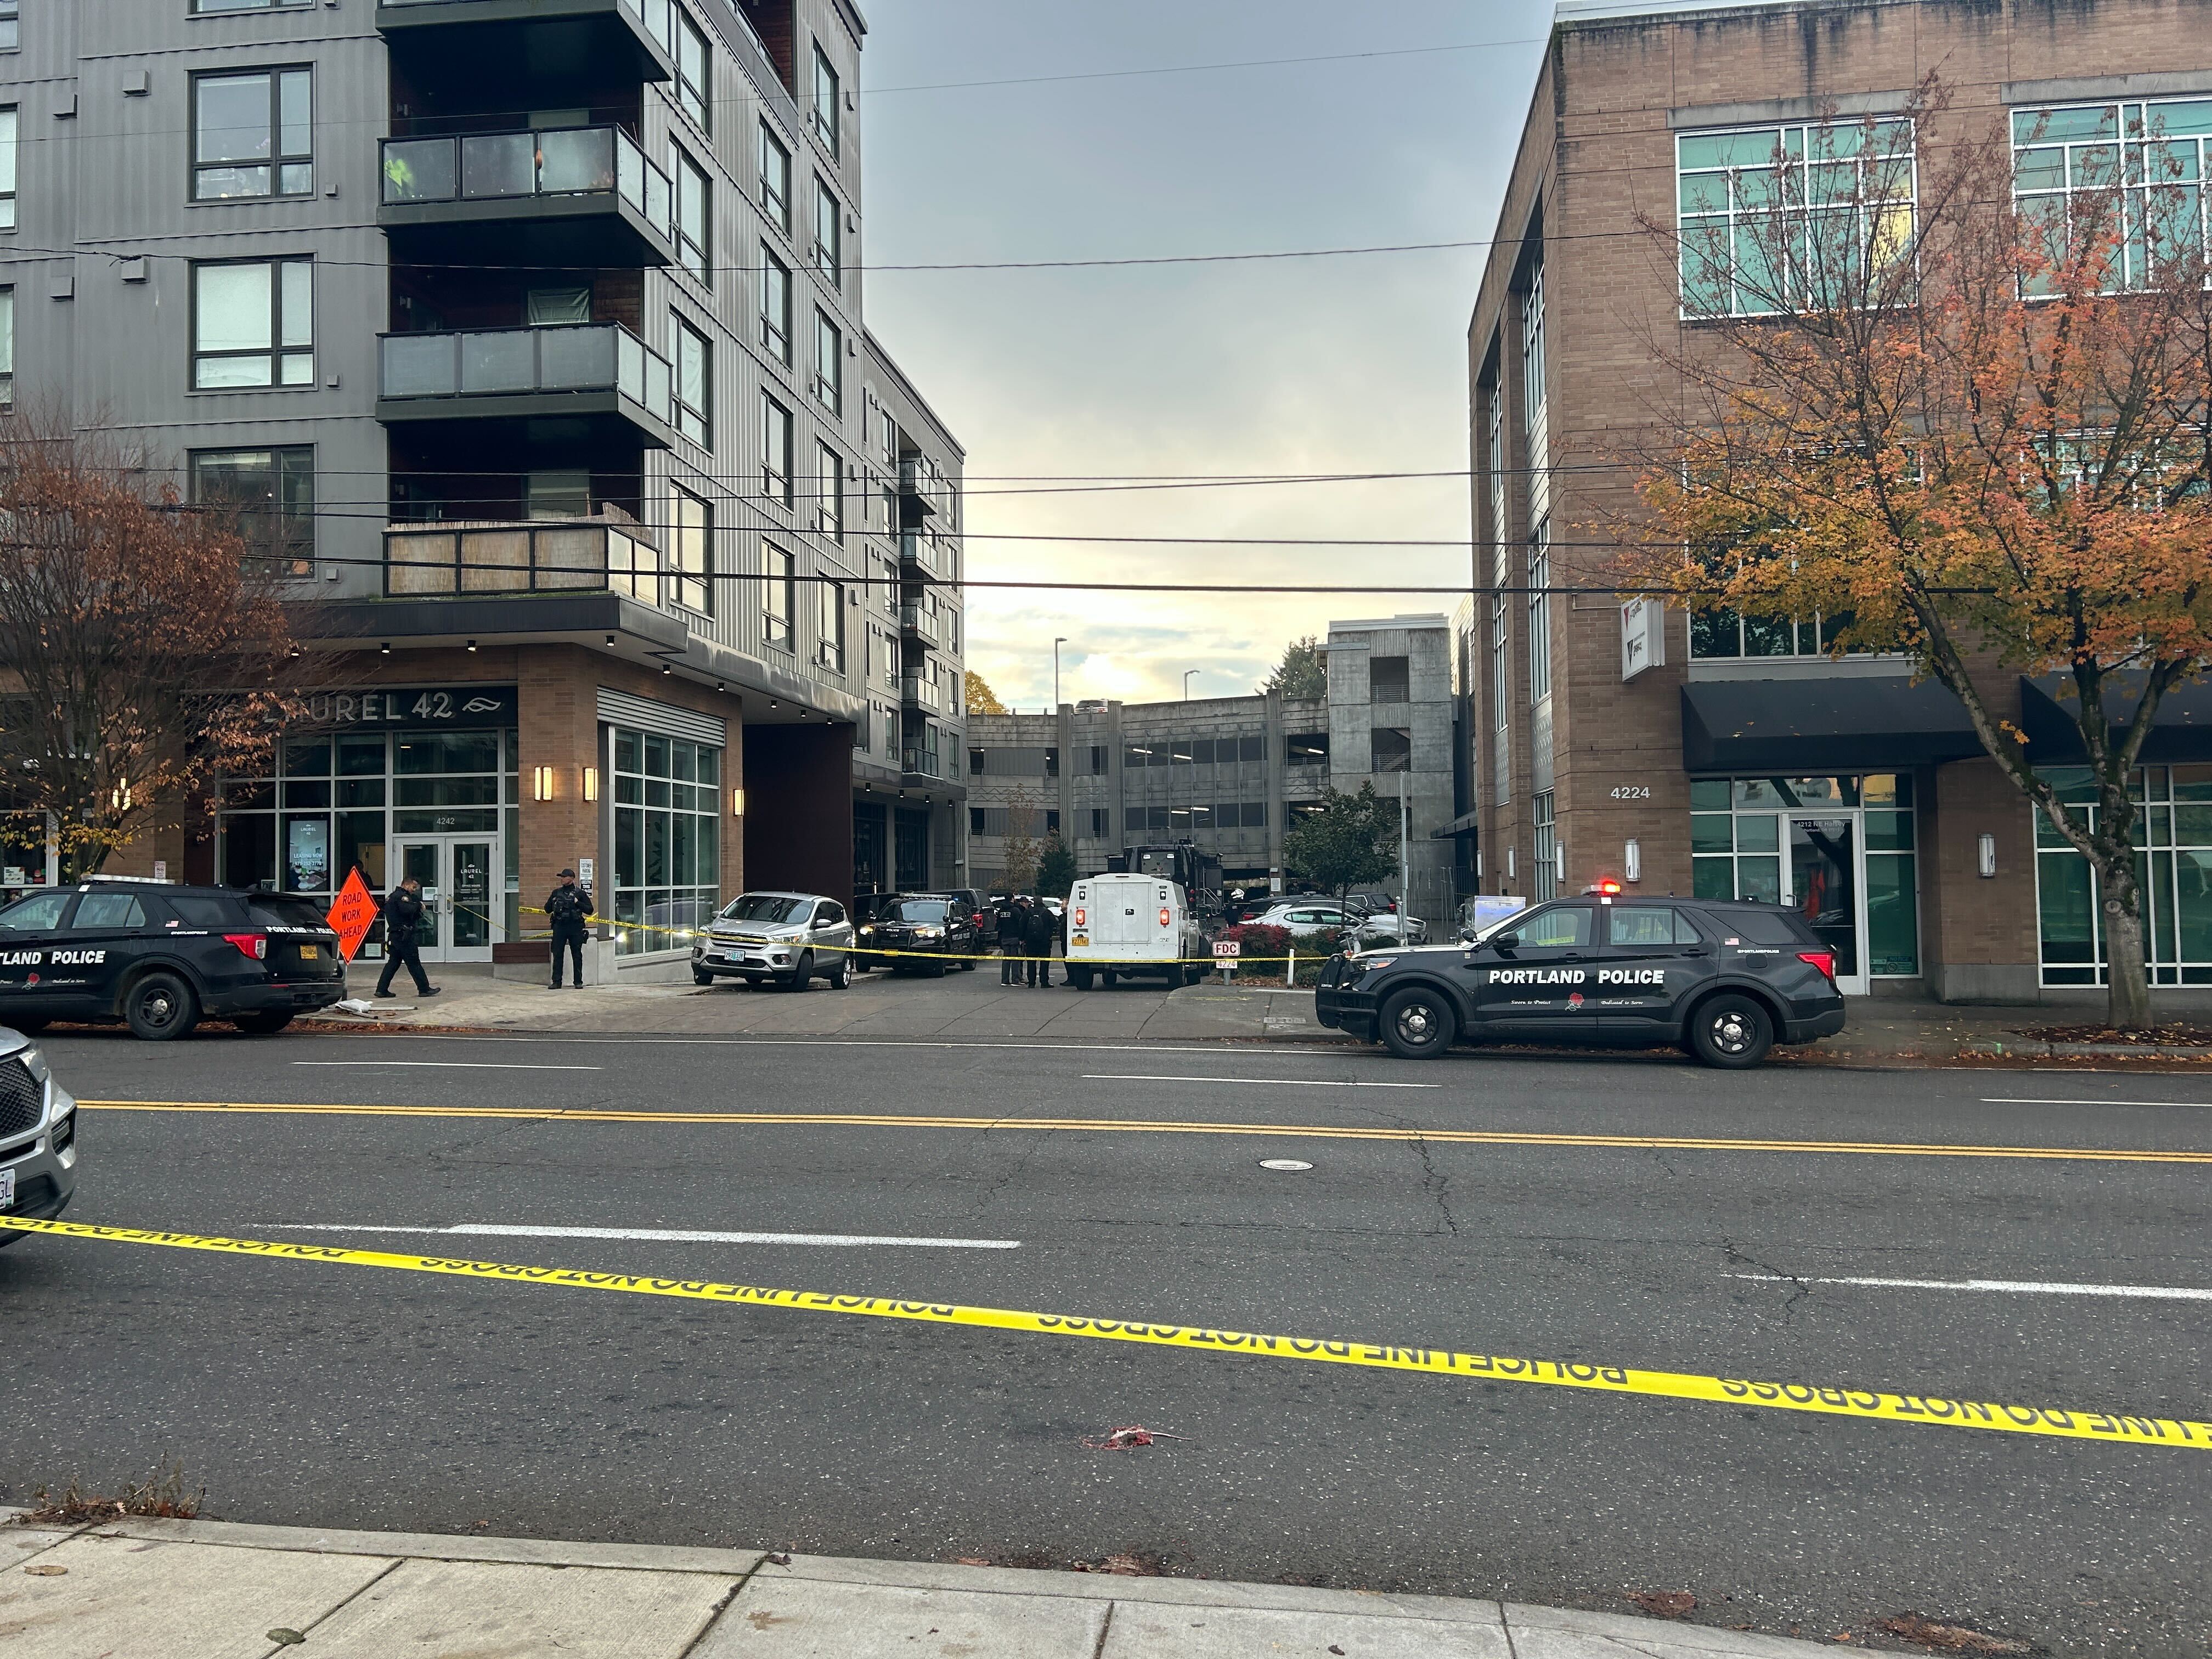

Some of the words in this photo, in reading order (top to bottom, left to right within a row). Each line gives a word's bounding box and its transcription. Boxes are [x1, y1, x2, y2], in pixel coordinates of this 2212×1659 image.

[412, 692, 453, 719] 42
[1610, 787, 1650, 799] 4224
[342, 892, 362, 906] ROAD
[342, 909, 361, 922] WORK
[339, 924, 362, 939] AHEAD
[1216, 944, 1237, 953] FDC
[51, 950, 106, 964] POLICE
[1489, 970, 1585, 984] PORTLAND
[1598, 970, 1664, 984] POLICE
